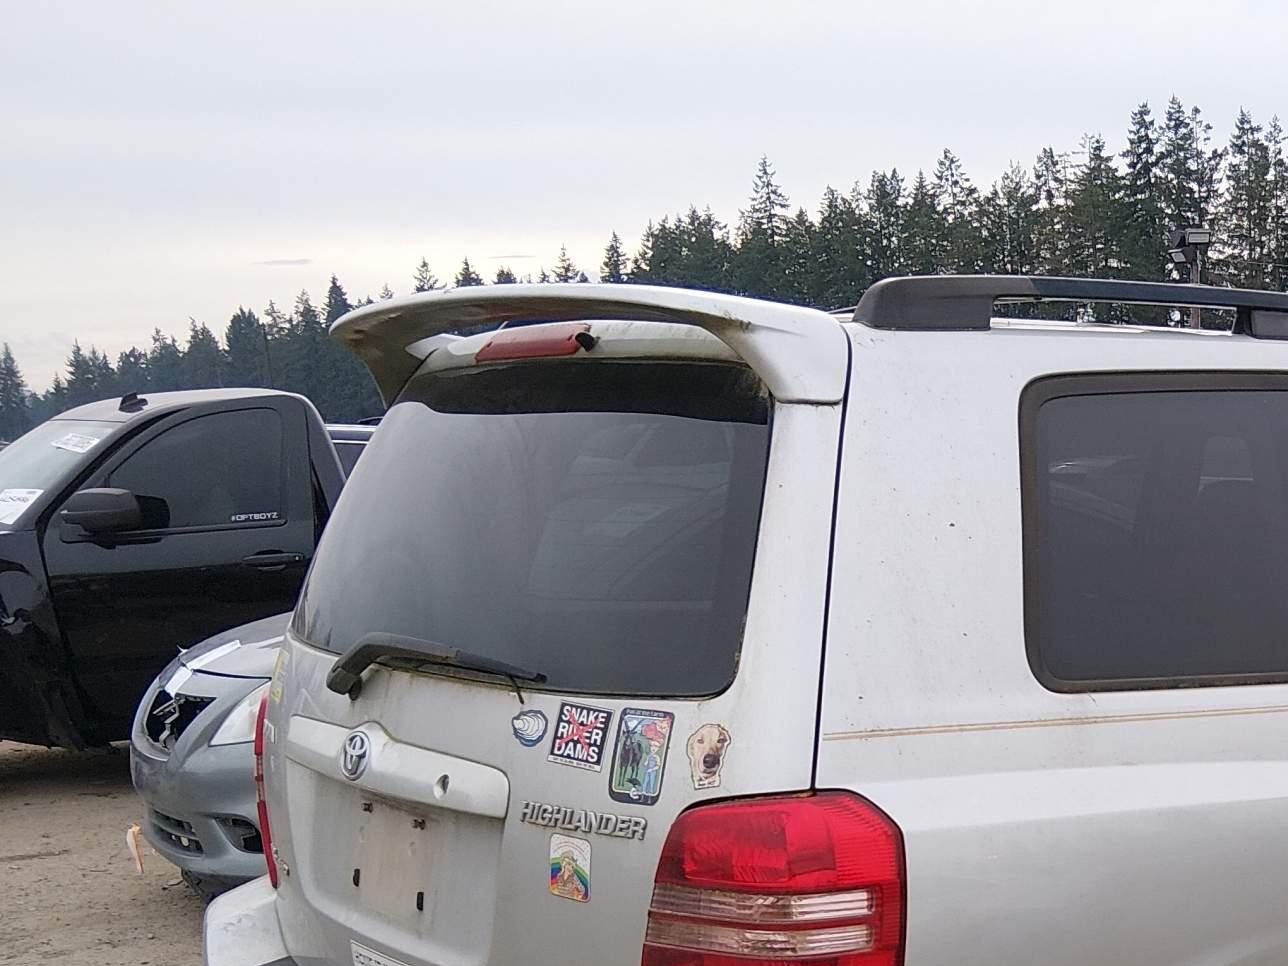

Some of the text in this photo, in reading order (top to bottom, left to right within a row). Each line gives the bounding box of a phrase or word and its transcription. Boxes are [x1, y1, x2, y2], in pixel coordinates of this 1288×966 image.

[561, 705, 608, 728] SNAKE
[553, 738, 599, 763] DAMS
[519, 800, 648, 841] HIGHLANDER
